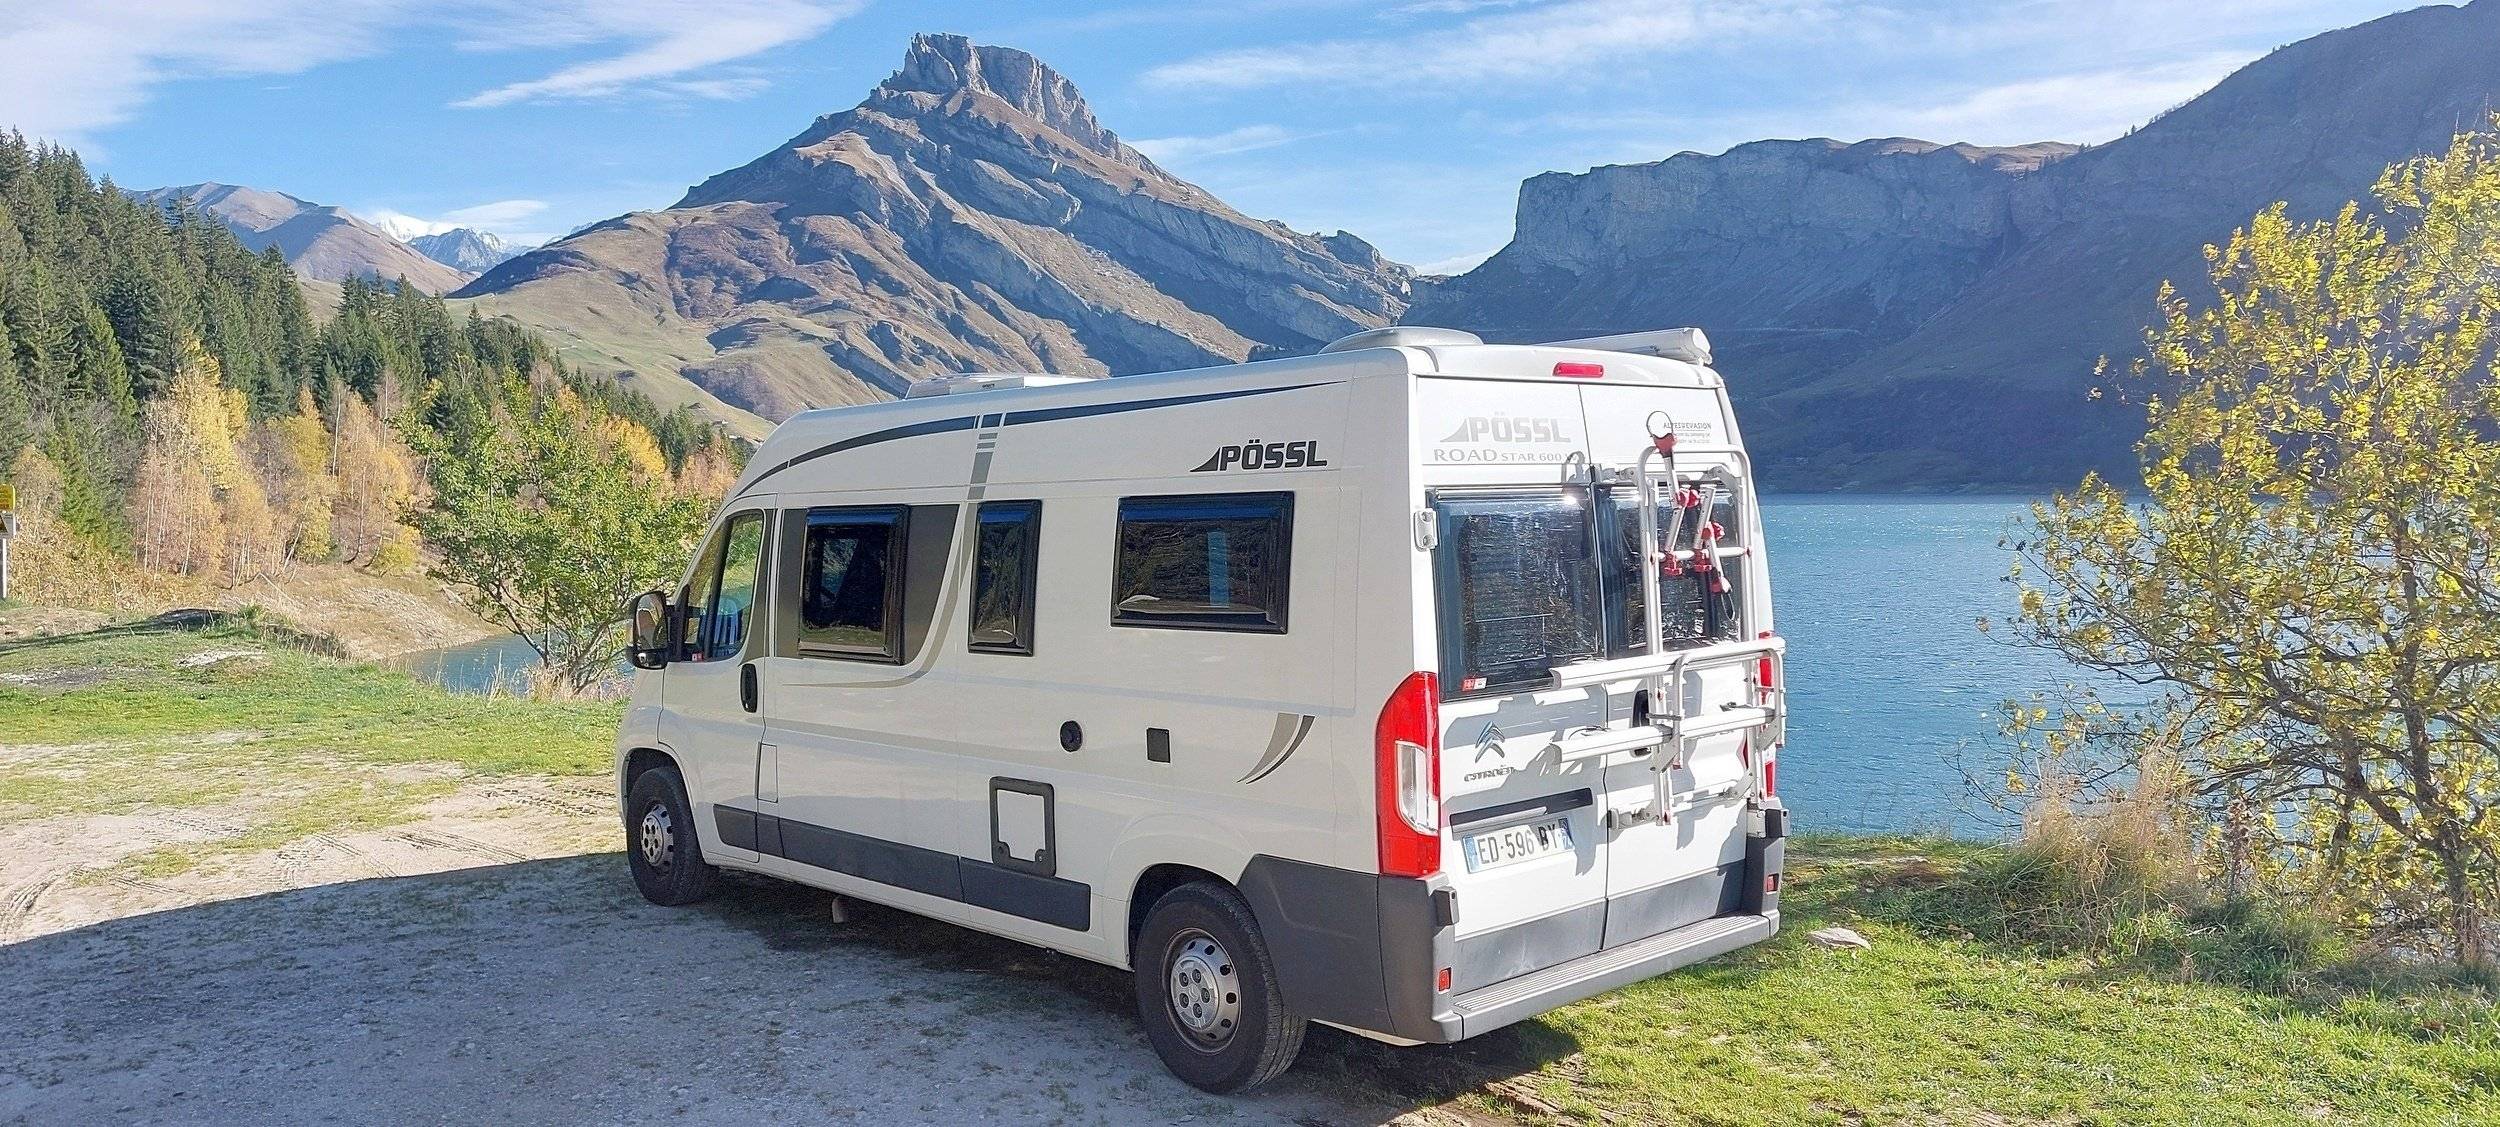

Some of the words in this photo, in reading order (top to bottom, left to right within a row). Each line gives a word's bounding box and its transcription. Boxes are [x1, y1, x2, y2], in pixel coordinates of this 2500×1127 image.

[1467, 411, 1571, 442] PÖSSL
[1219, 439, 1327, 471] PÖSSL
[1433, 449, 1498, 462] ROAD
[1501, 452, 1536, 462] STAR
[1539, 452, 1562, 462] 600
